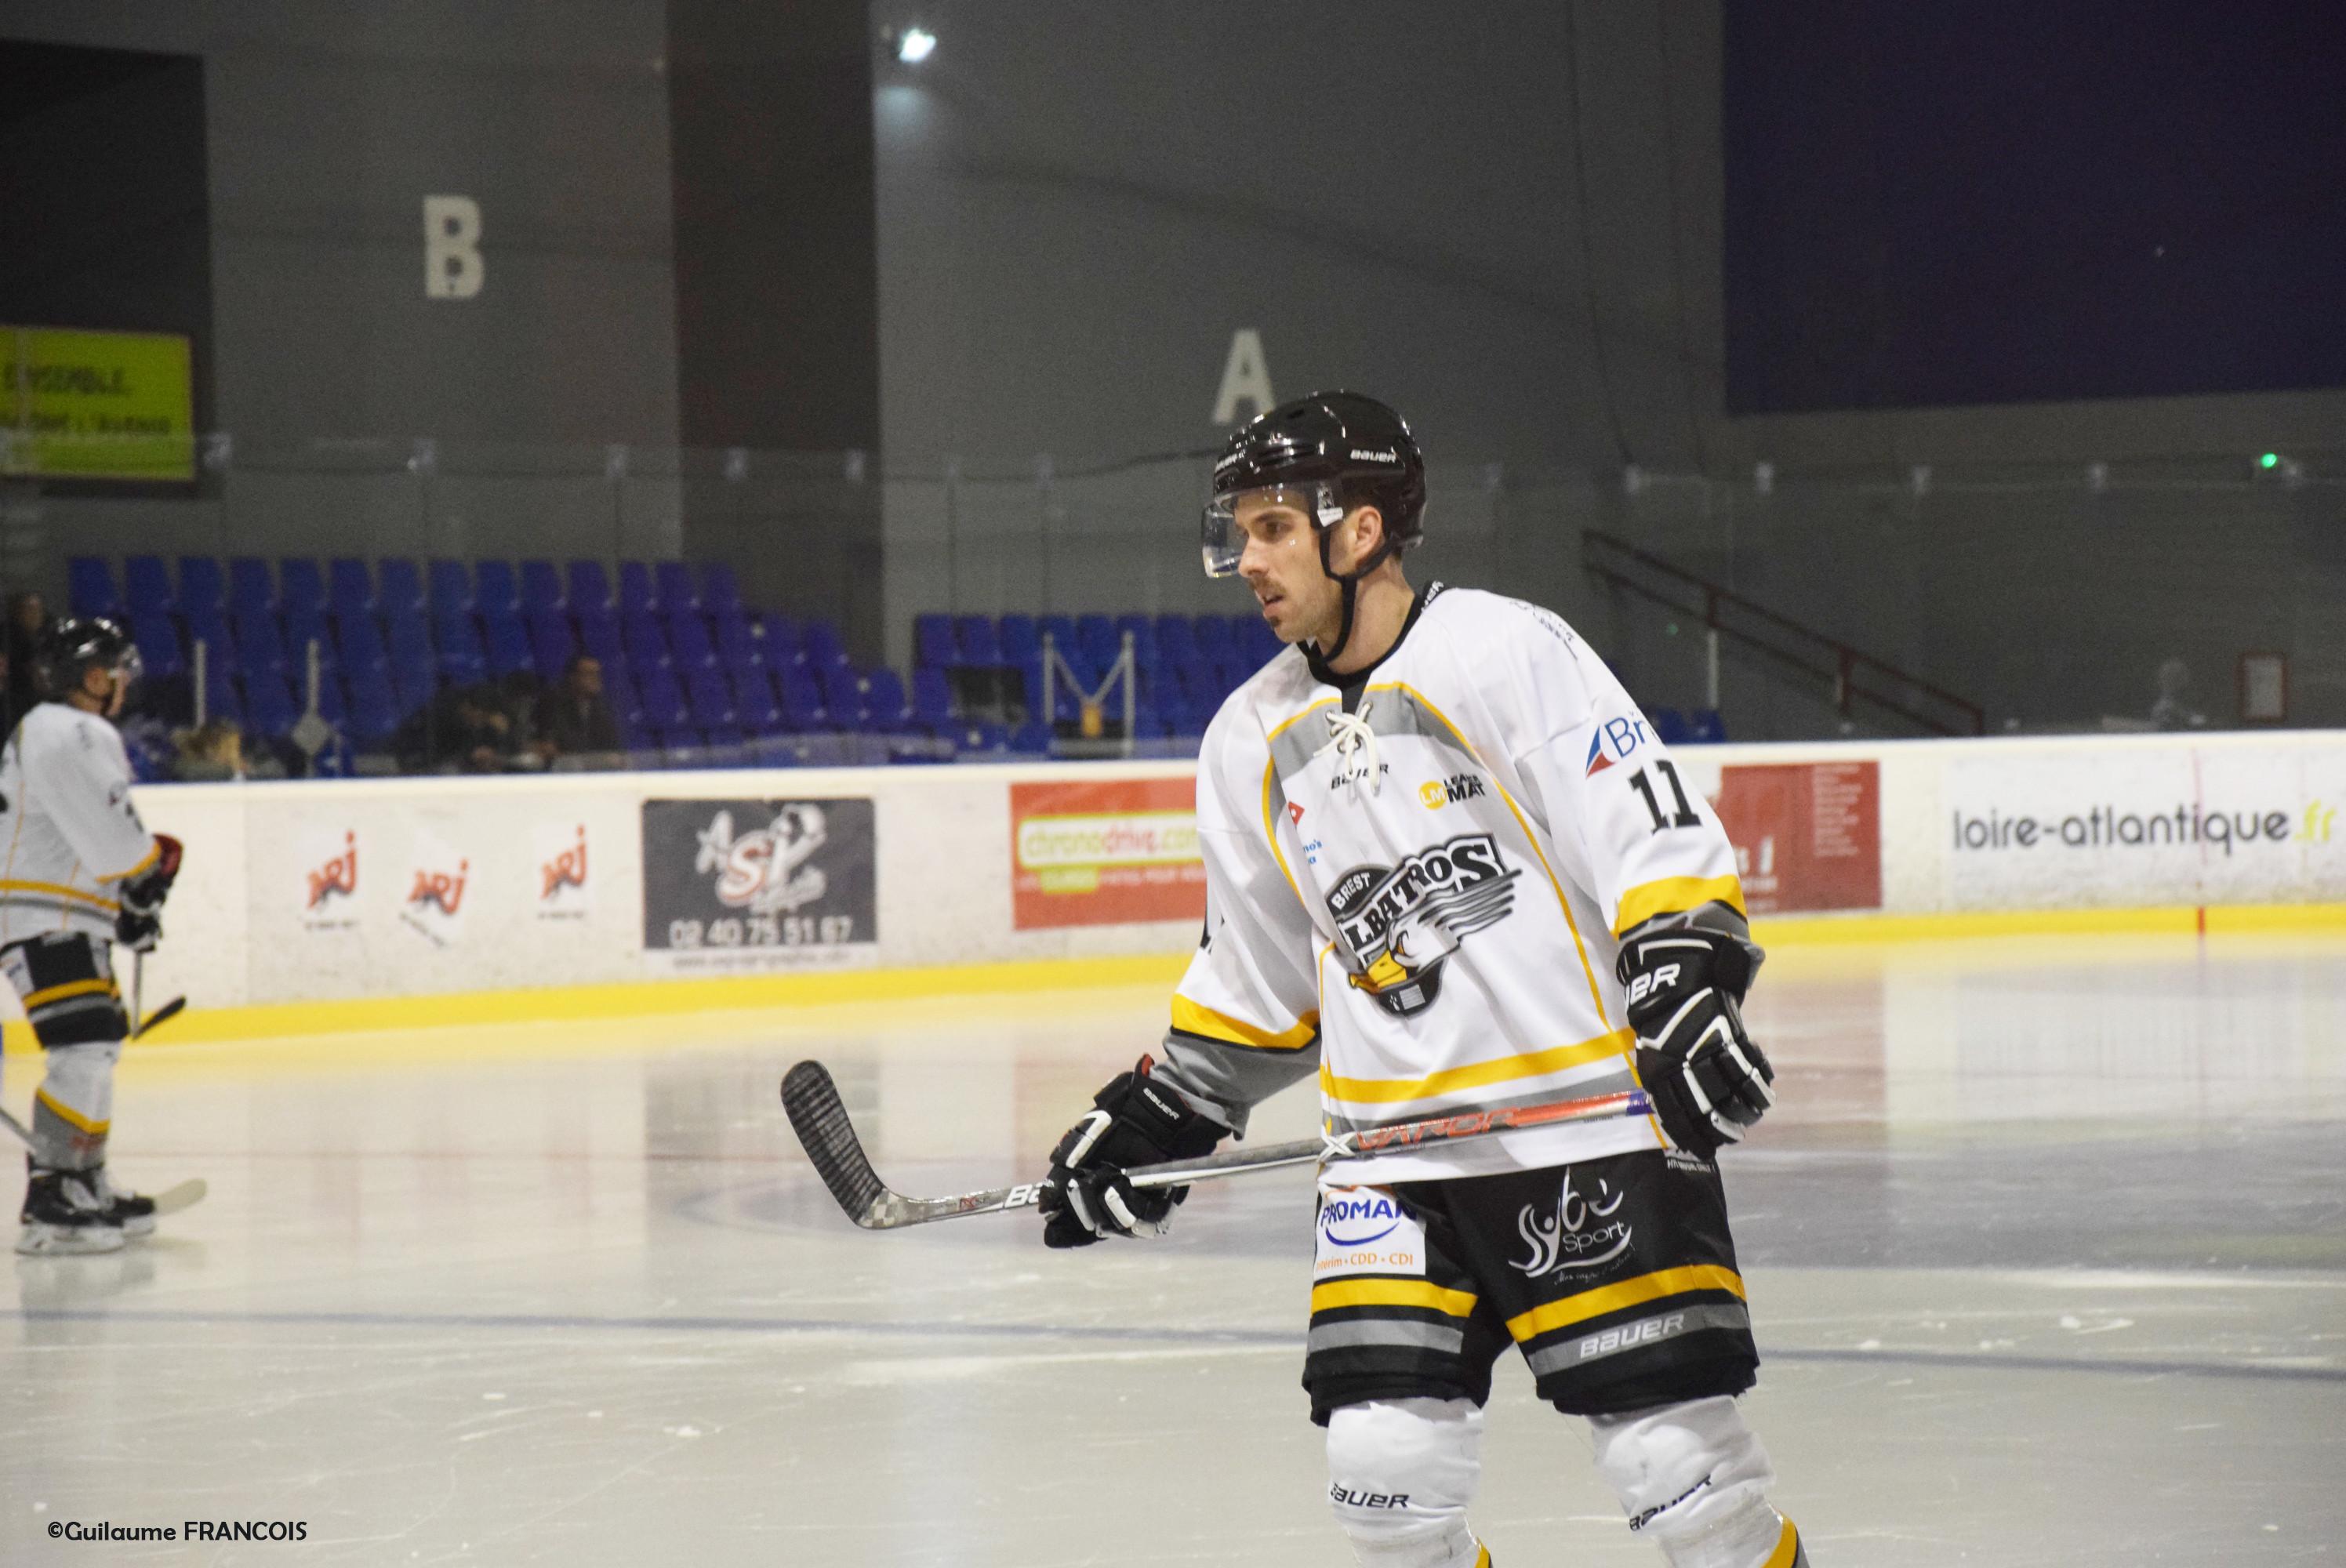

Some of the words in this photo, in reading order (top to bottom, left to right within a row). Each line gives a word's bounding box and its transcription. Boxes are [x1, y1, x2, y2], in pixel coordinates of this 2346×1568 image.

[423, 194, 485, 299] B
[1212, 329, 1276, 423] A
[1349, 448, 1396, 463] BAUER
[1447, 785, 1486, 804] MAT
[1627, 759, 1702, 836] 11
[1331, 872, 1371, 910] BREST
[707, 918, 743, 946] 40
[1142, 1087, 1180, 1120] BAUER
[1350, 1253, 1378, 1265] CDD
[1389, 1253, 1414, 1266] CDI
[1580, 1313, 1685, 1359] BAUER
